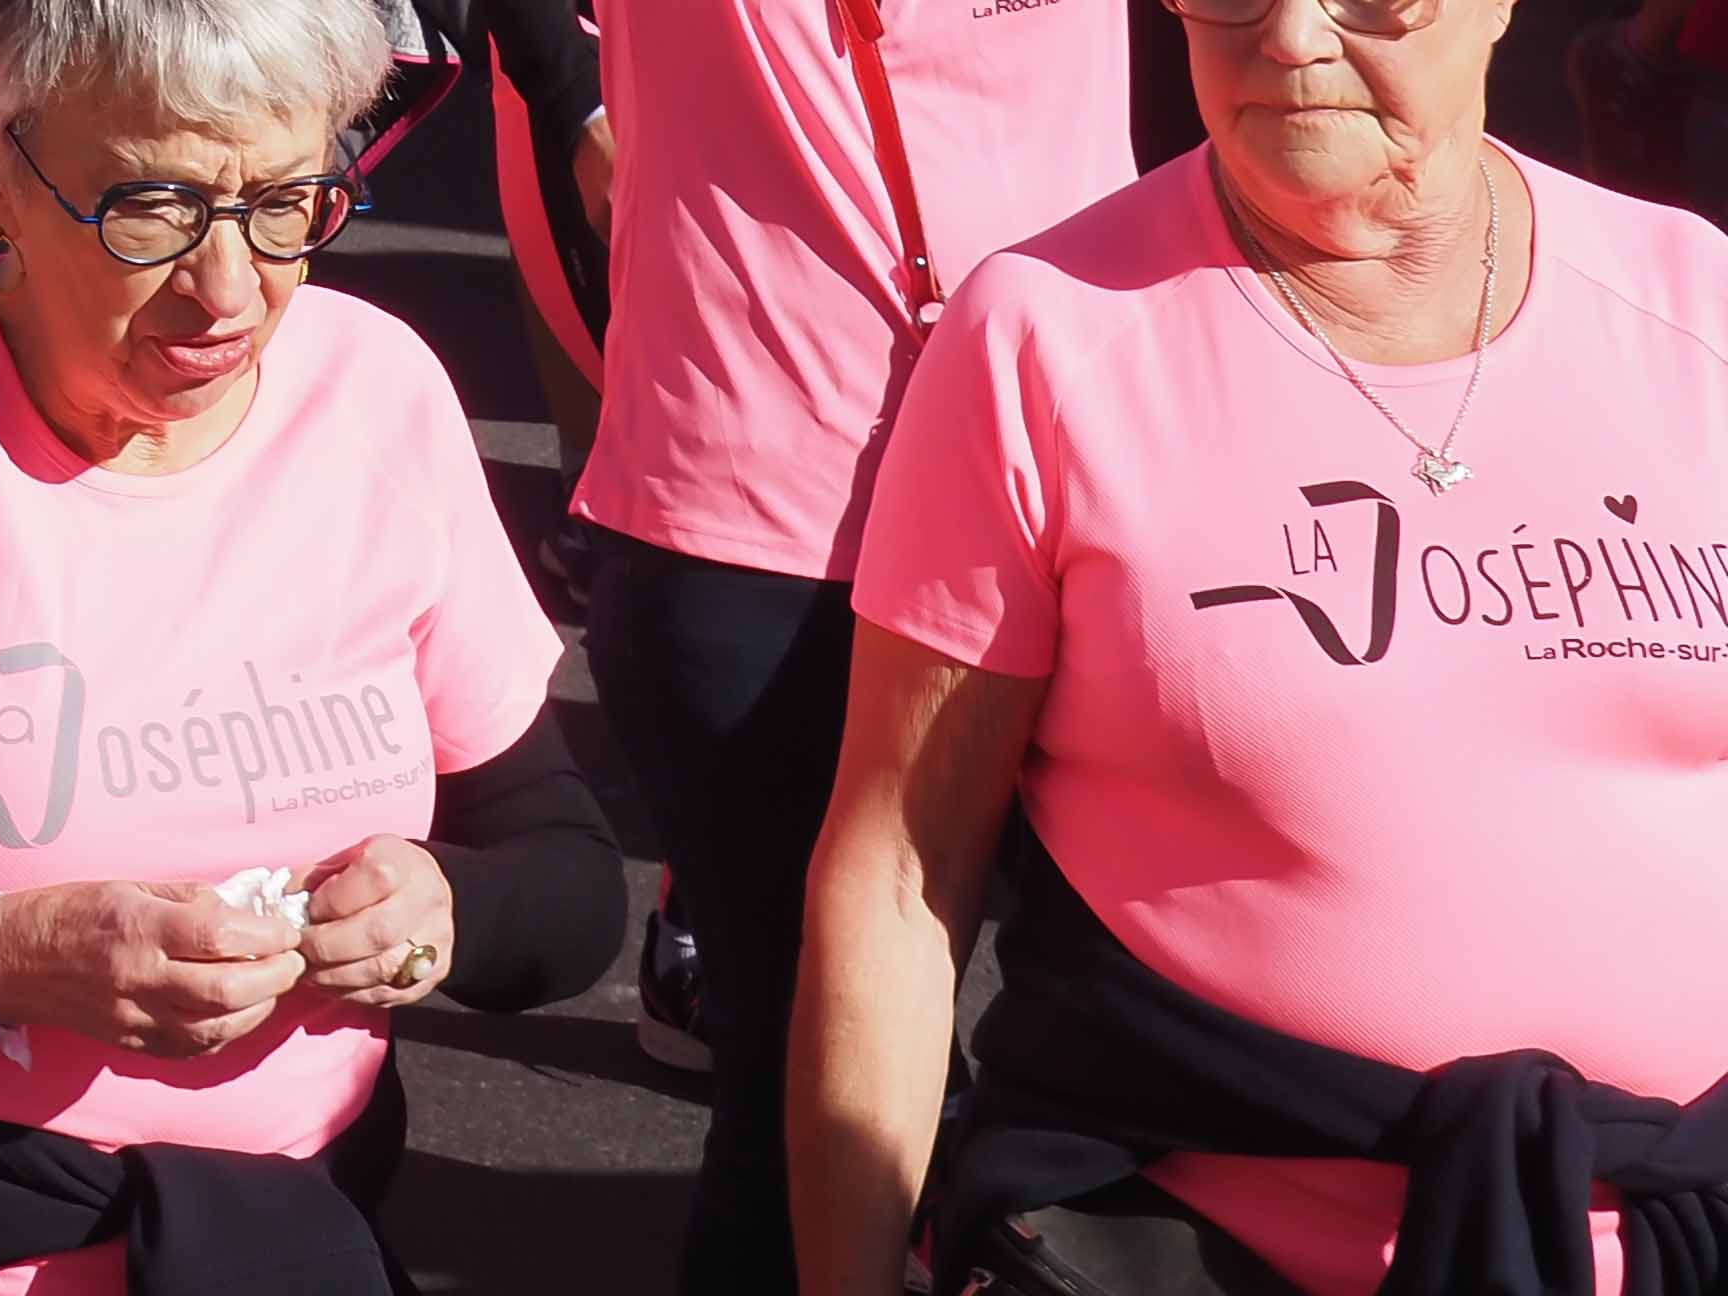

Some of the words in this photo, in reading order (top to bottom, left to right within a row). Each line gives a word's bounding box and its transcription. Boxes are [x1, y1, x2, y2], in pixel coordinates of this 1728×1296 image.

[973, 6, 993, 19] La
[1283, 519, 1338, 576] LA
[1524, 643, 1556, 661] La
[1562, 637, 1728, 663] Roche-sur-
[272, 795, 299, 812] La
